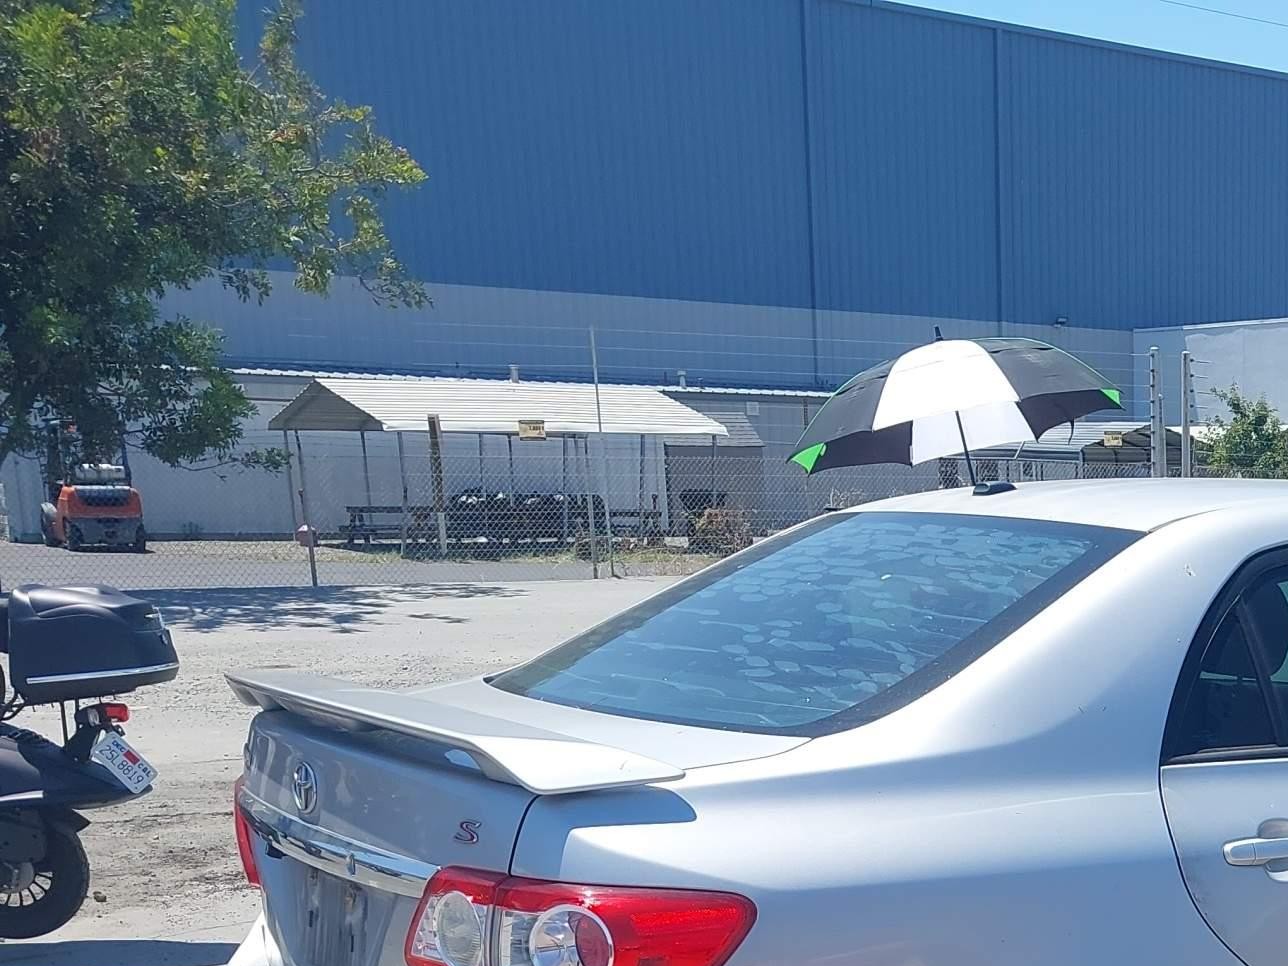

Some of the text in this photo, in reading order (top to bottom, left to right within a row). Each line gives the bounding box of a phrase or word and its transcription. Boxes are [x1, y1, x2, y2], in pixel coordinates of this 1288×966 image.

[98, 744, 145, 785] 25L8819
[137, 762, 152, 778] CAL
[453, 818, 482, 845] S
